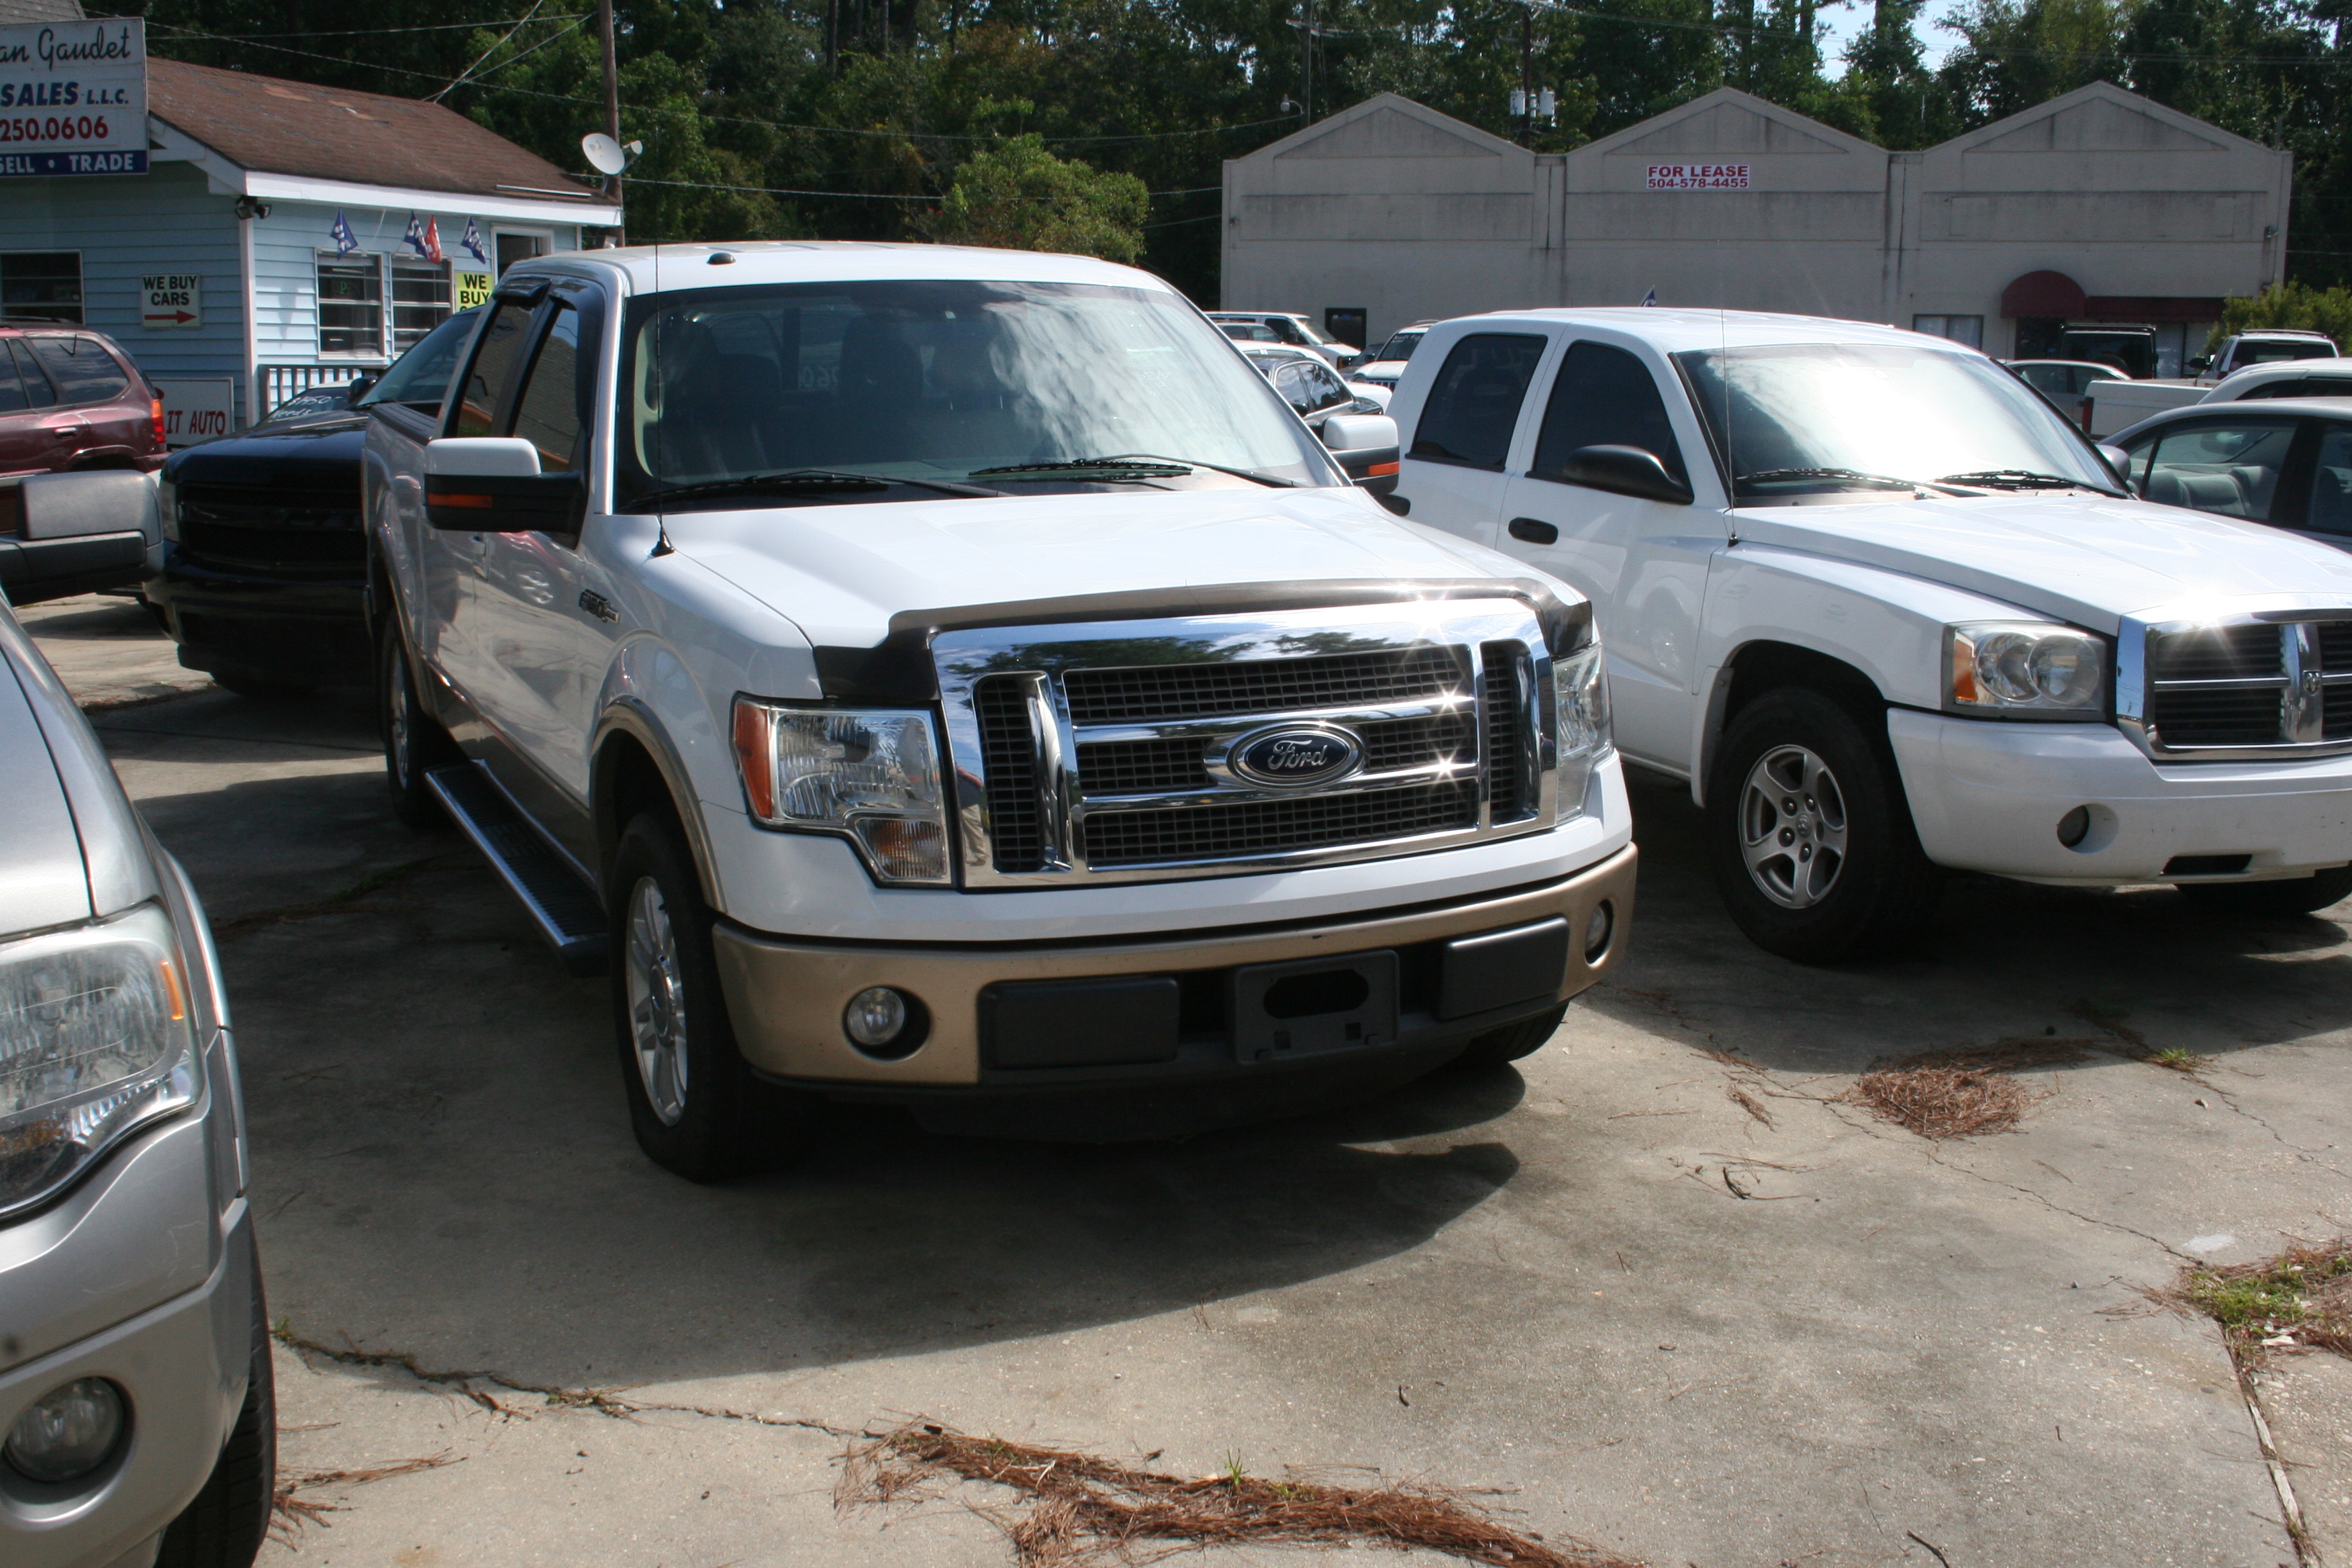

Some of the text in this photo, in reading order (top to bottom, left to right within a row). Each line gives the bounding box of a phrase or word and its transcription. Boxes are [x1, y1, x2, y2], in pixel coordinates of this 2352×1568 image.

[38, 26, 131, 71] Gaudet
[1, 82, 129, 107] SALES L.L.C.
[69, 153, 134, 172] TRADE
[1649, 166, 1749, 177] FOR LEASE
[1648, 178, 1749, 189] 504-578-4455
[143, 275, 197, 290] WE BUY
[464, 274, 487, 290] WE
[151, 291, 190, 306] CARS
[460, 290, 490, 305] BUY
[189, 410, 226, 436] AUTO
[1267, 740, 1328, 770] Ford
